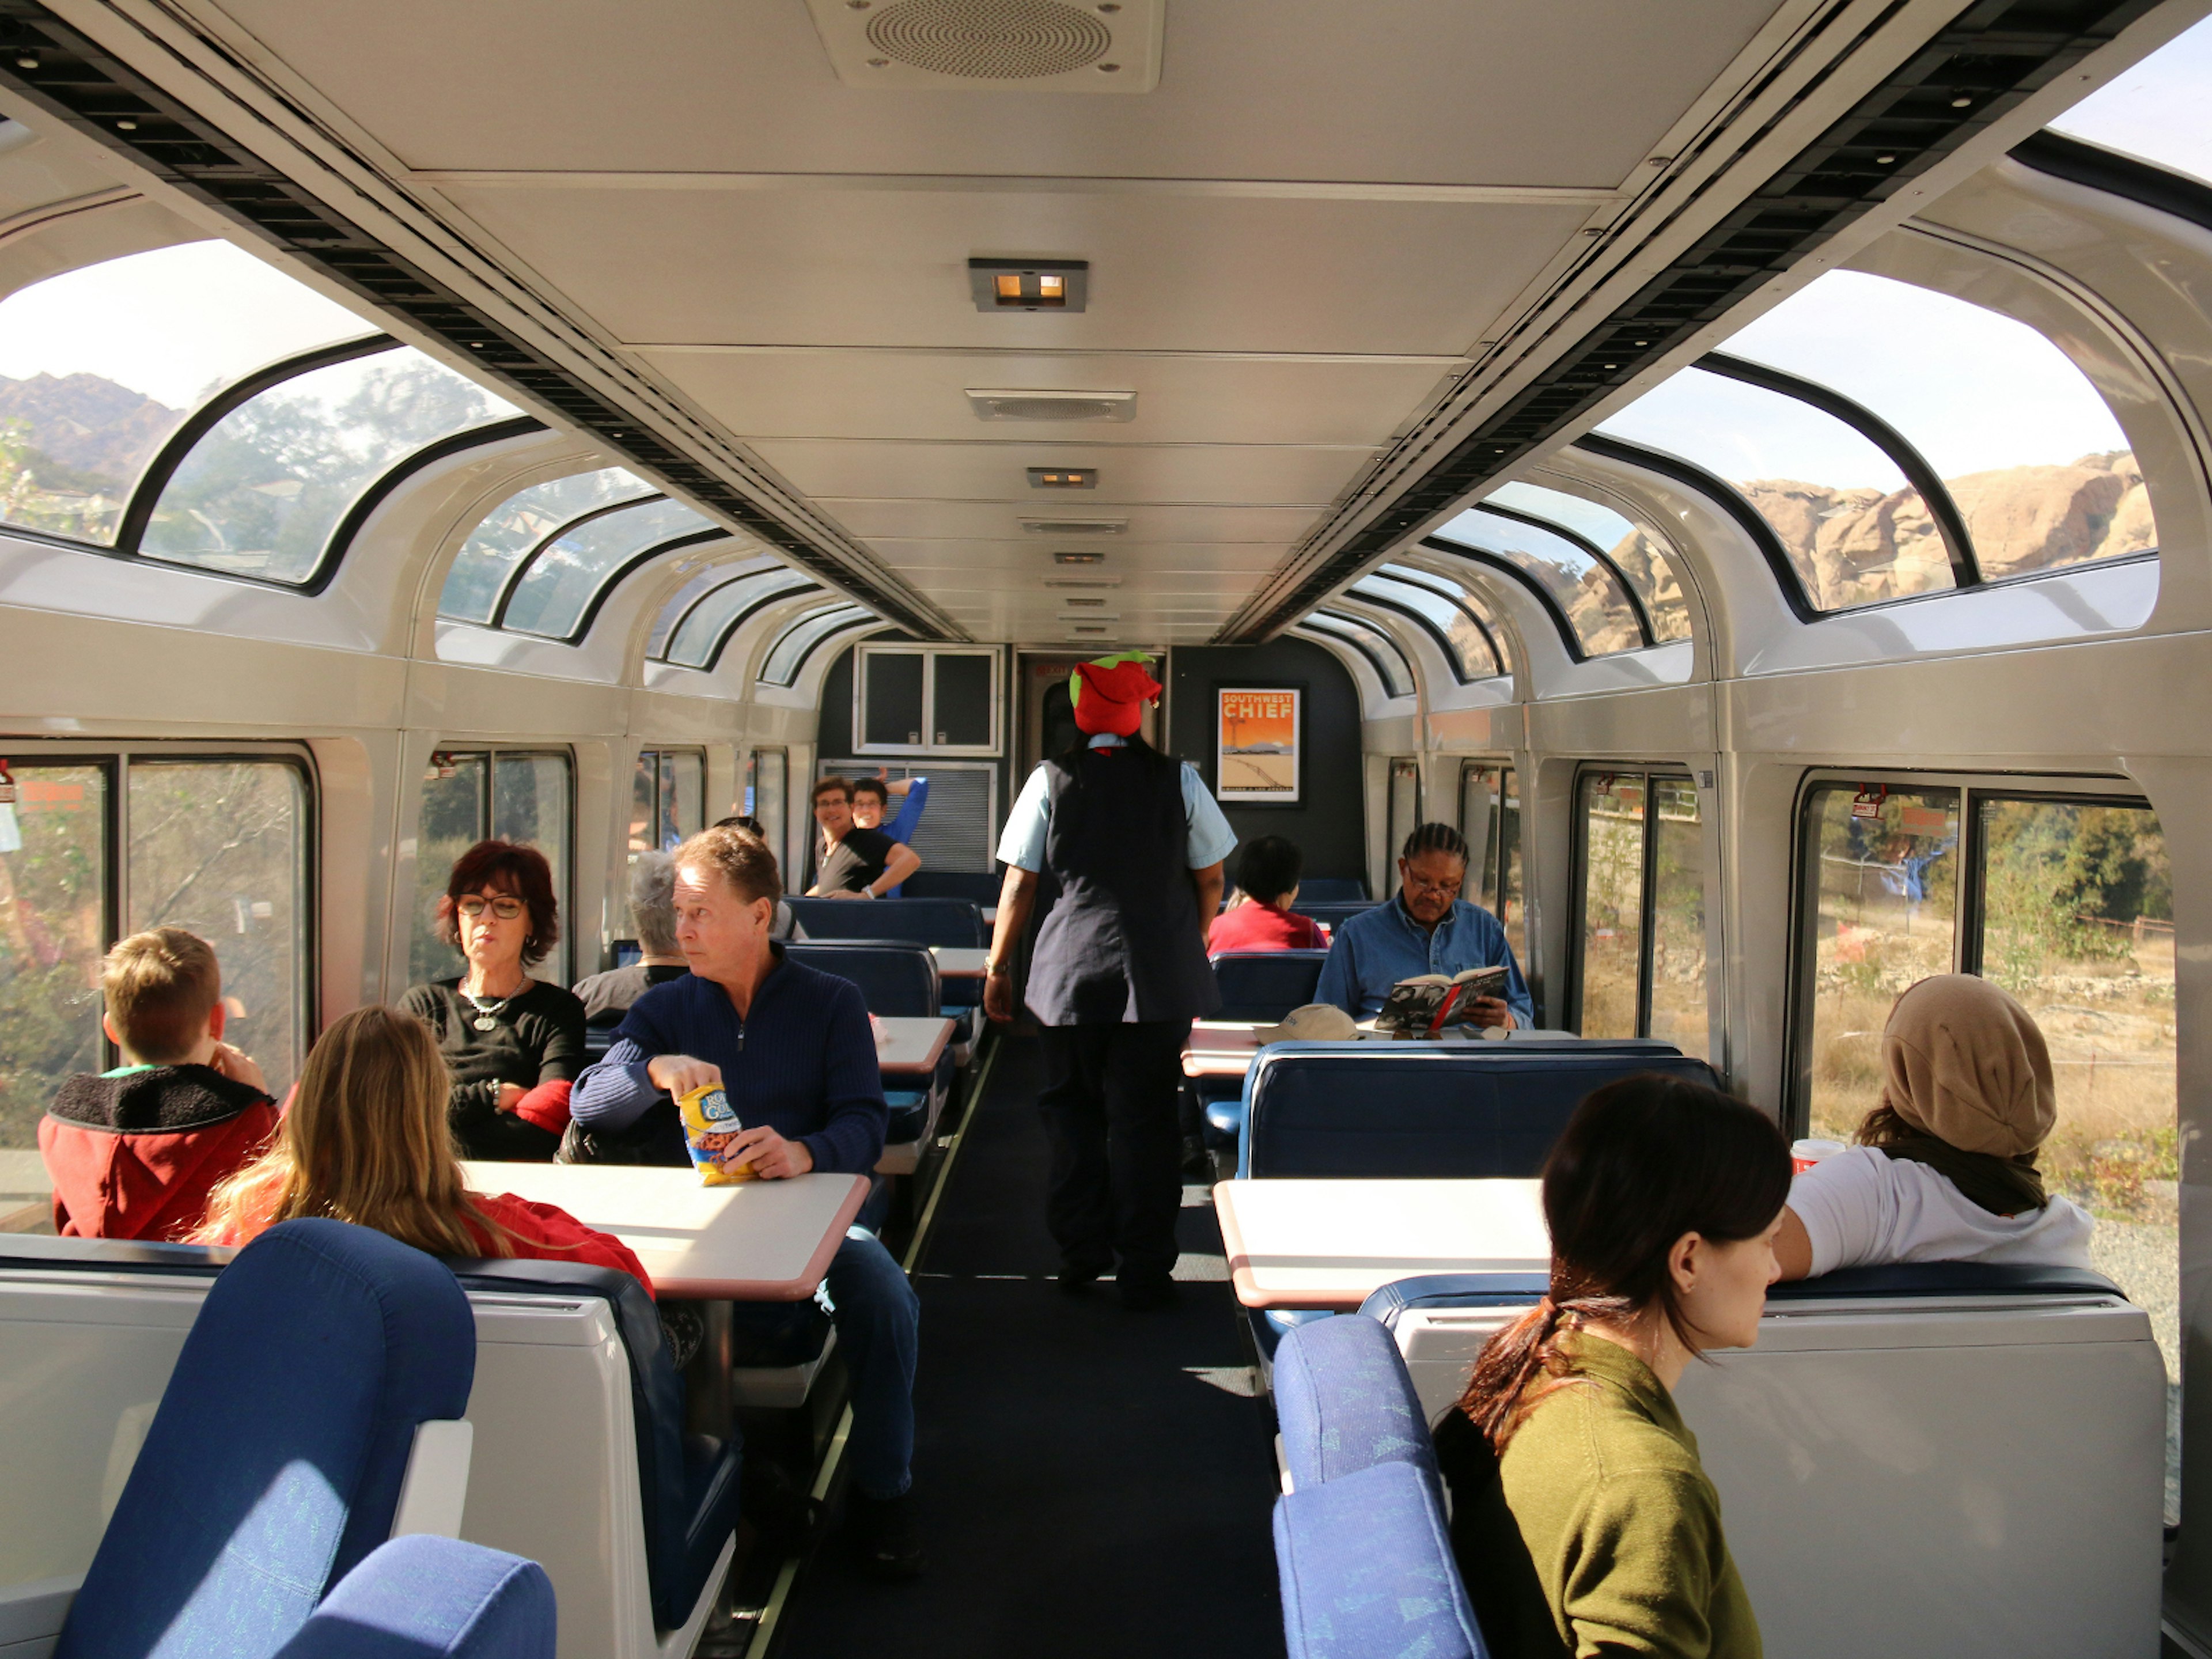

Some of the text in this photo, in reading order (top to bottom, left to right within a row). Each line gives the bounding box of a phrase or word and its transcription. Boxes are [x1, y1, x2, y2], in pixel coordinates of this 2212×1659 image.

[1046, 665, 1066, 673] EXIT
[1224, 695, 1292, 703] SOUTHWEST
[1224, 703, 1292, 718] CHIEF
